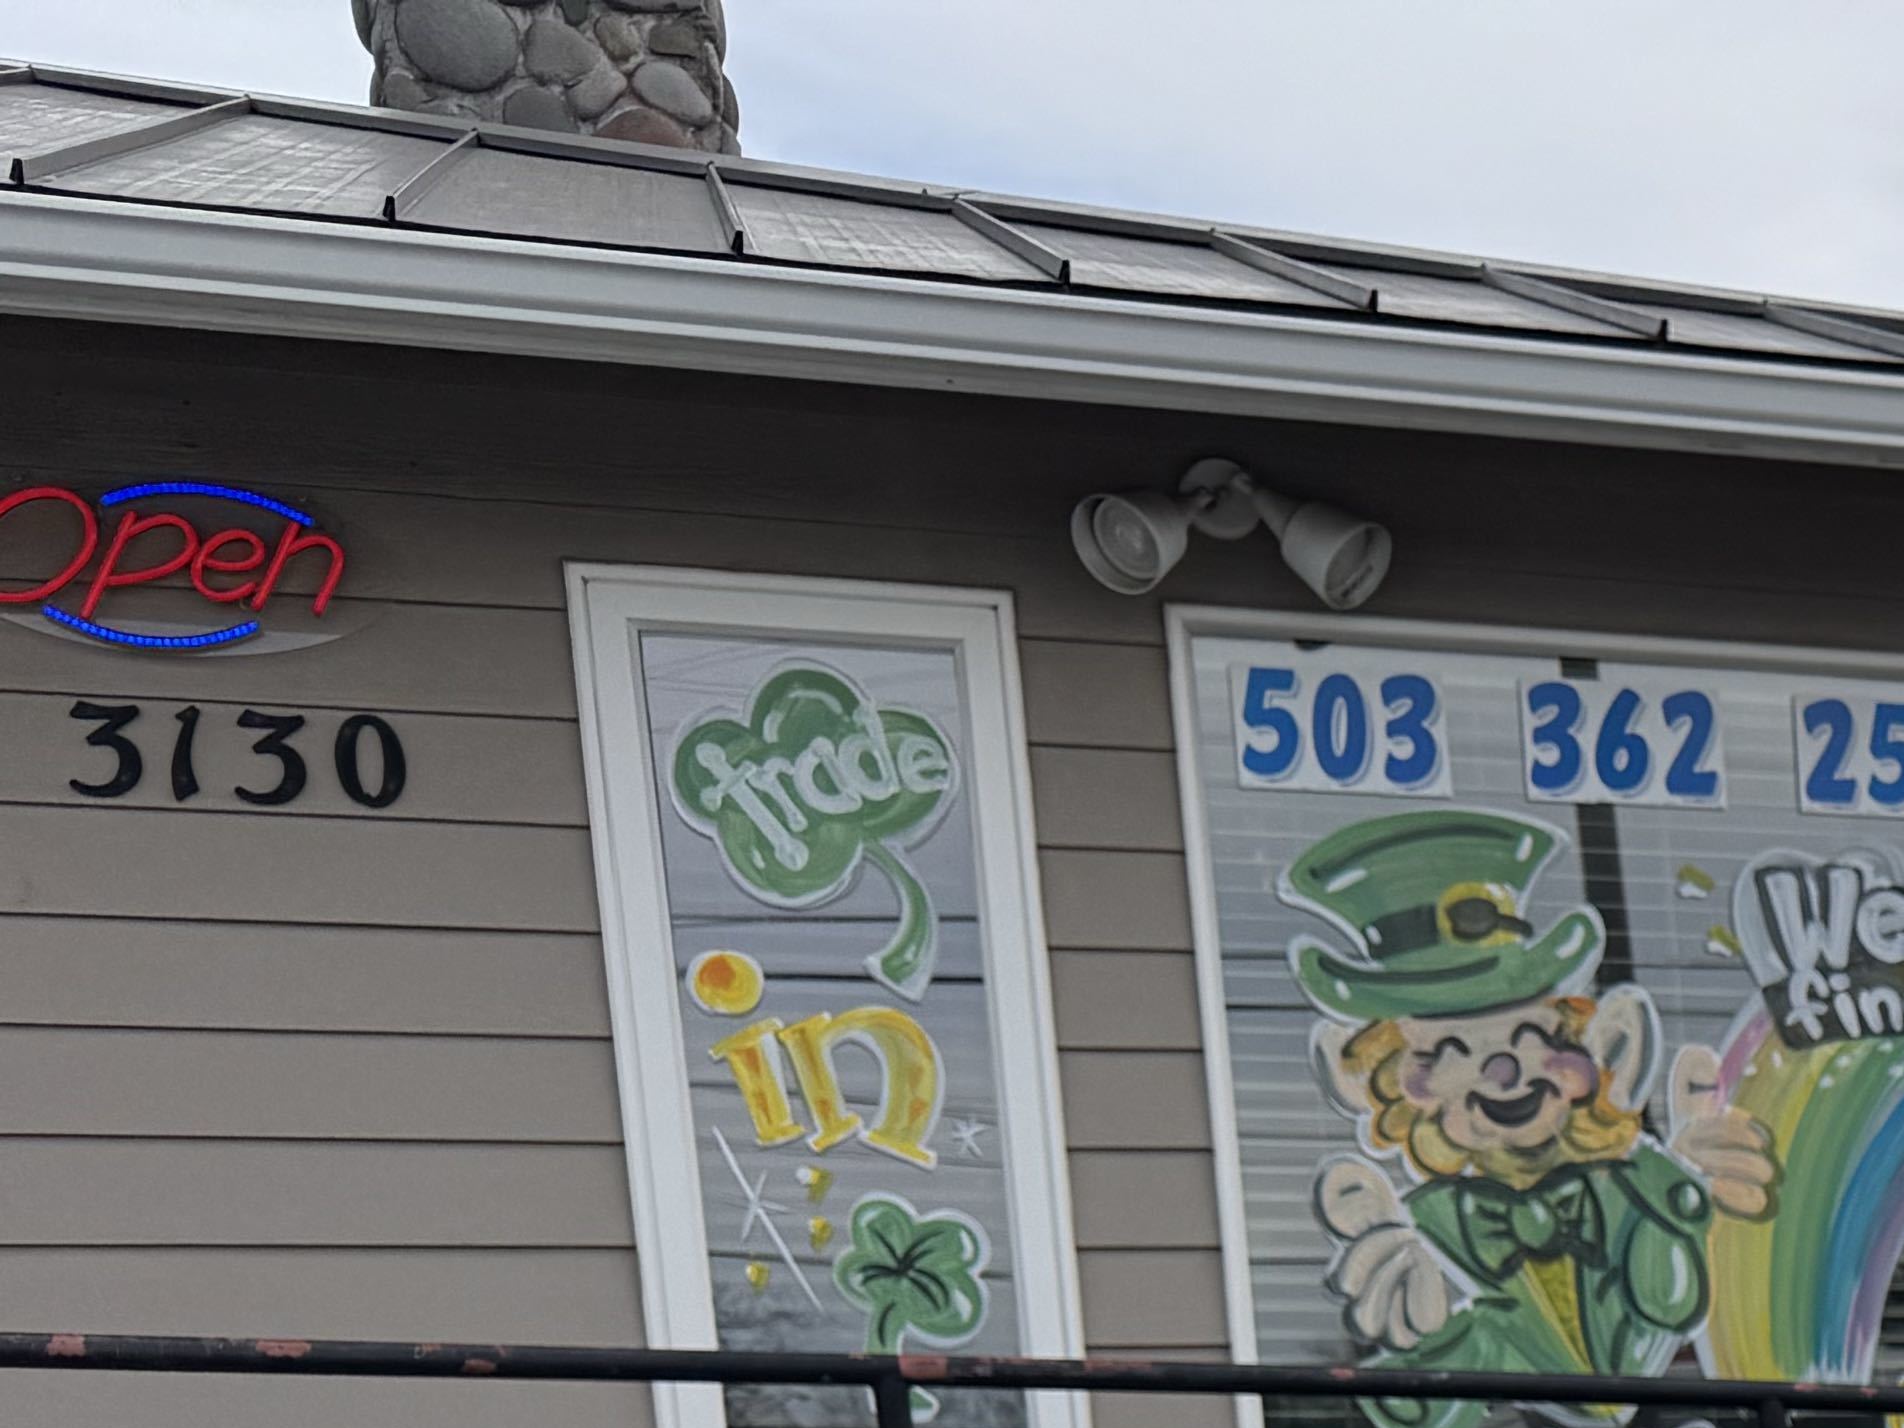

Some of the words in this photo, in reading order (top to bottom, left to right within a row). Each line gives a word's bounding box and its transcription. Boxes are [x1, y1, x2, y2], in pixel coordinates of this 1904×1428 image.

[0, 485, 345, 620] Open
[69, 700, 406, 808] 3130
[694, 699, 949, 871] trade
[1241, 666, 1442, 788] 503
[1527, 681, 1720, 798] 362
